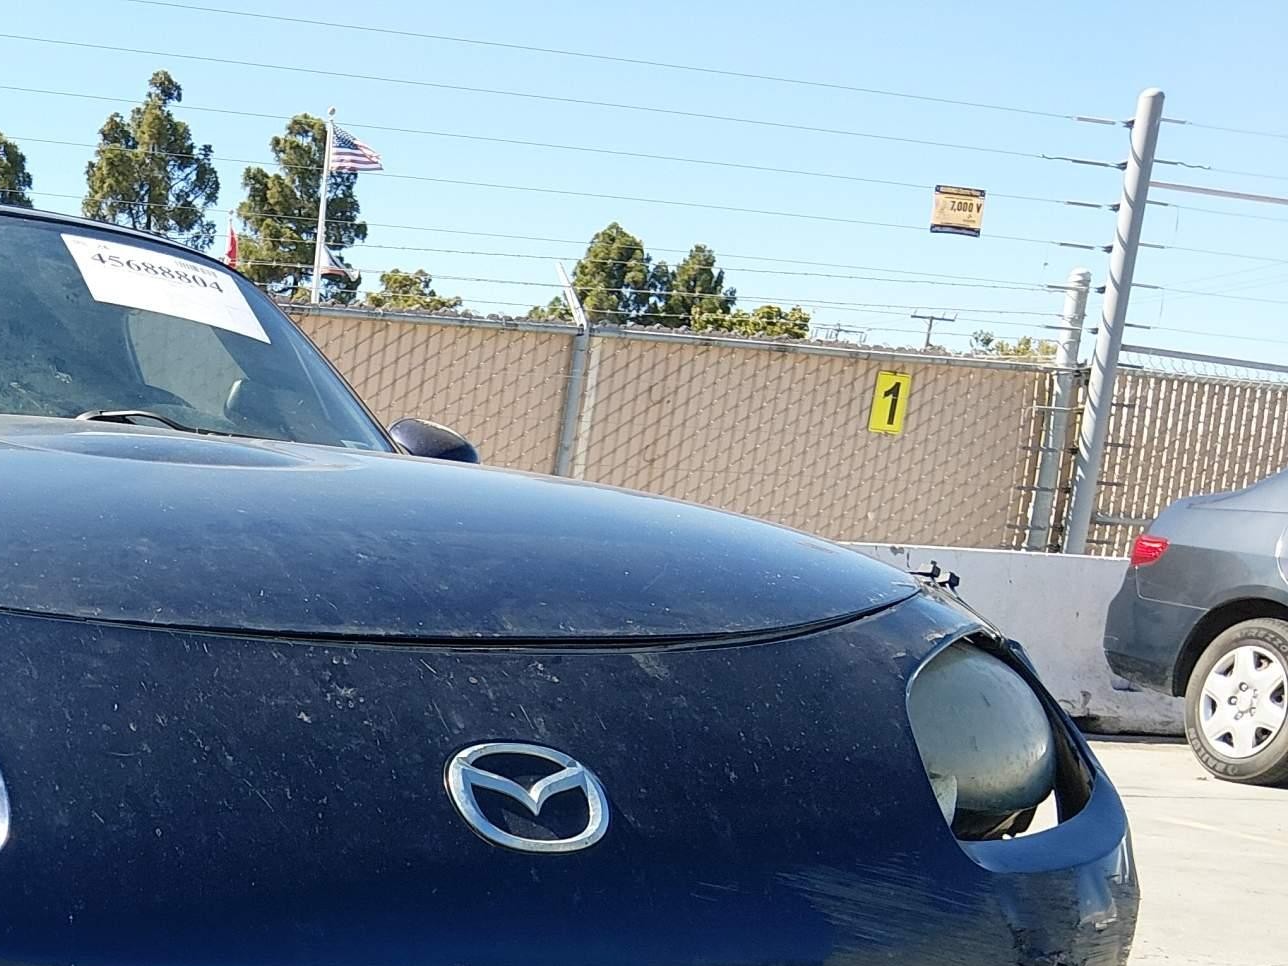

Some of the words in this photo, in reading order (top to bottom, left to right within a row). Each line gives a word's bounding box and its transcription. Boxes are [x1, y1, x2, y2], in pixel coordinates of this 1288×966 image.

[950, 201, 973, 212] 7,000
[976, 203, 982, 213] V
[90, 253, 224, 293] 45688804
[882, 381, 902, 426] 1
